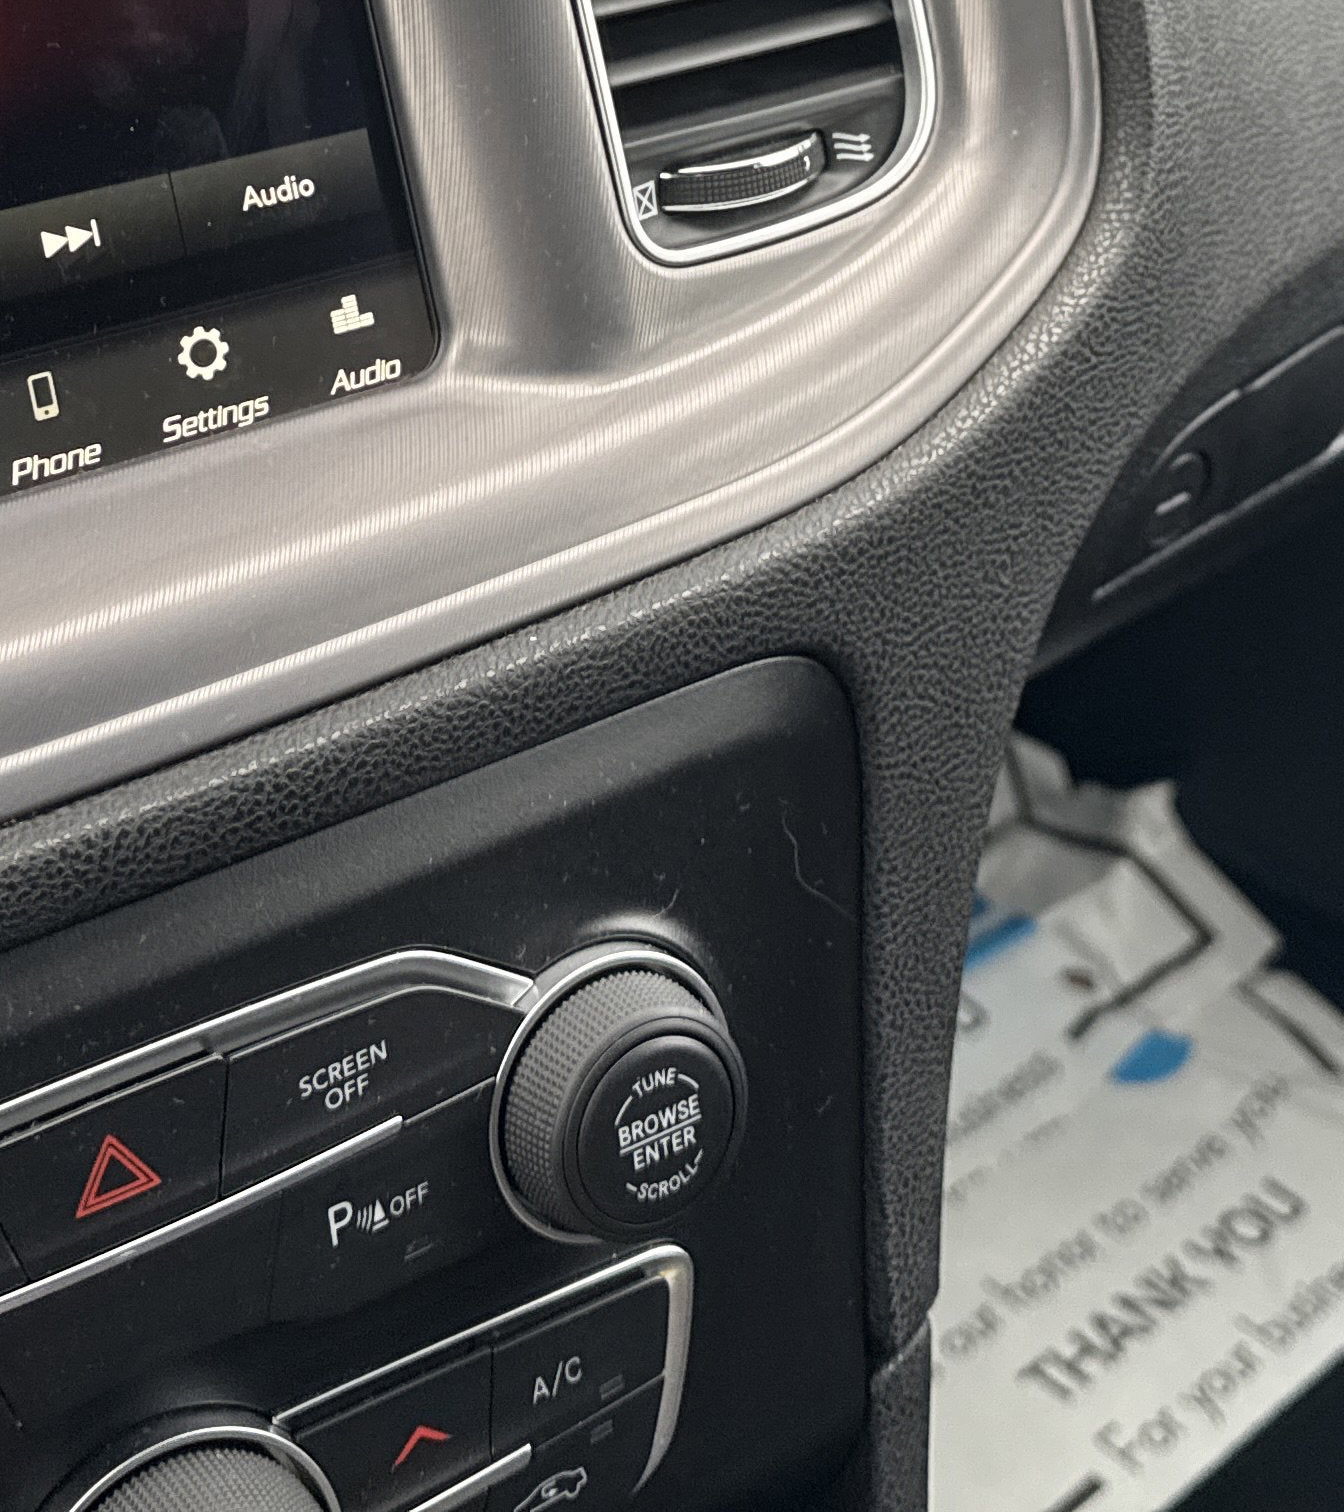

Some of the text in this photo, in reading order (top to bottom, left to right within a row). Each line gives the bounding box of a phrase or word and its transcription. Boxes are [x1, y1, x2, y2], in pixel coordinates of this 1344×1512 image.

[241, 174, 316, 213] Audio
[330, 357, 402, 396] Audio
[162, 395, 271, 444] Settings
[11, 442, 103, 486] Phone
[298, 1039, 389, 1099] SCREEN
[324, 1073, 370, 1110] OFF
[631, 1067, 678, 1098] TUNE
[617, 1092, 701, 1148] BROWSE
[633, 1126, 697, 1172] ENTER
[636, 1163, 698, 1201] SCROLL
[327, 1180, 429, 1248] P OFF
[1016, 1174, 1311, 1403] THANK YOU
[532, 1355, 583, 1405] A/C
[1092, 1403, 1187, 1475] For
[1175, 1338, 1261, 1426] your
